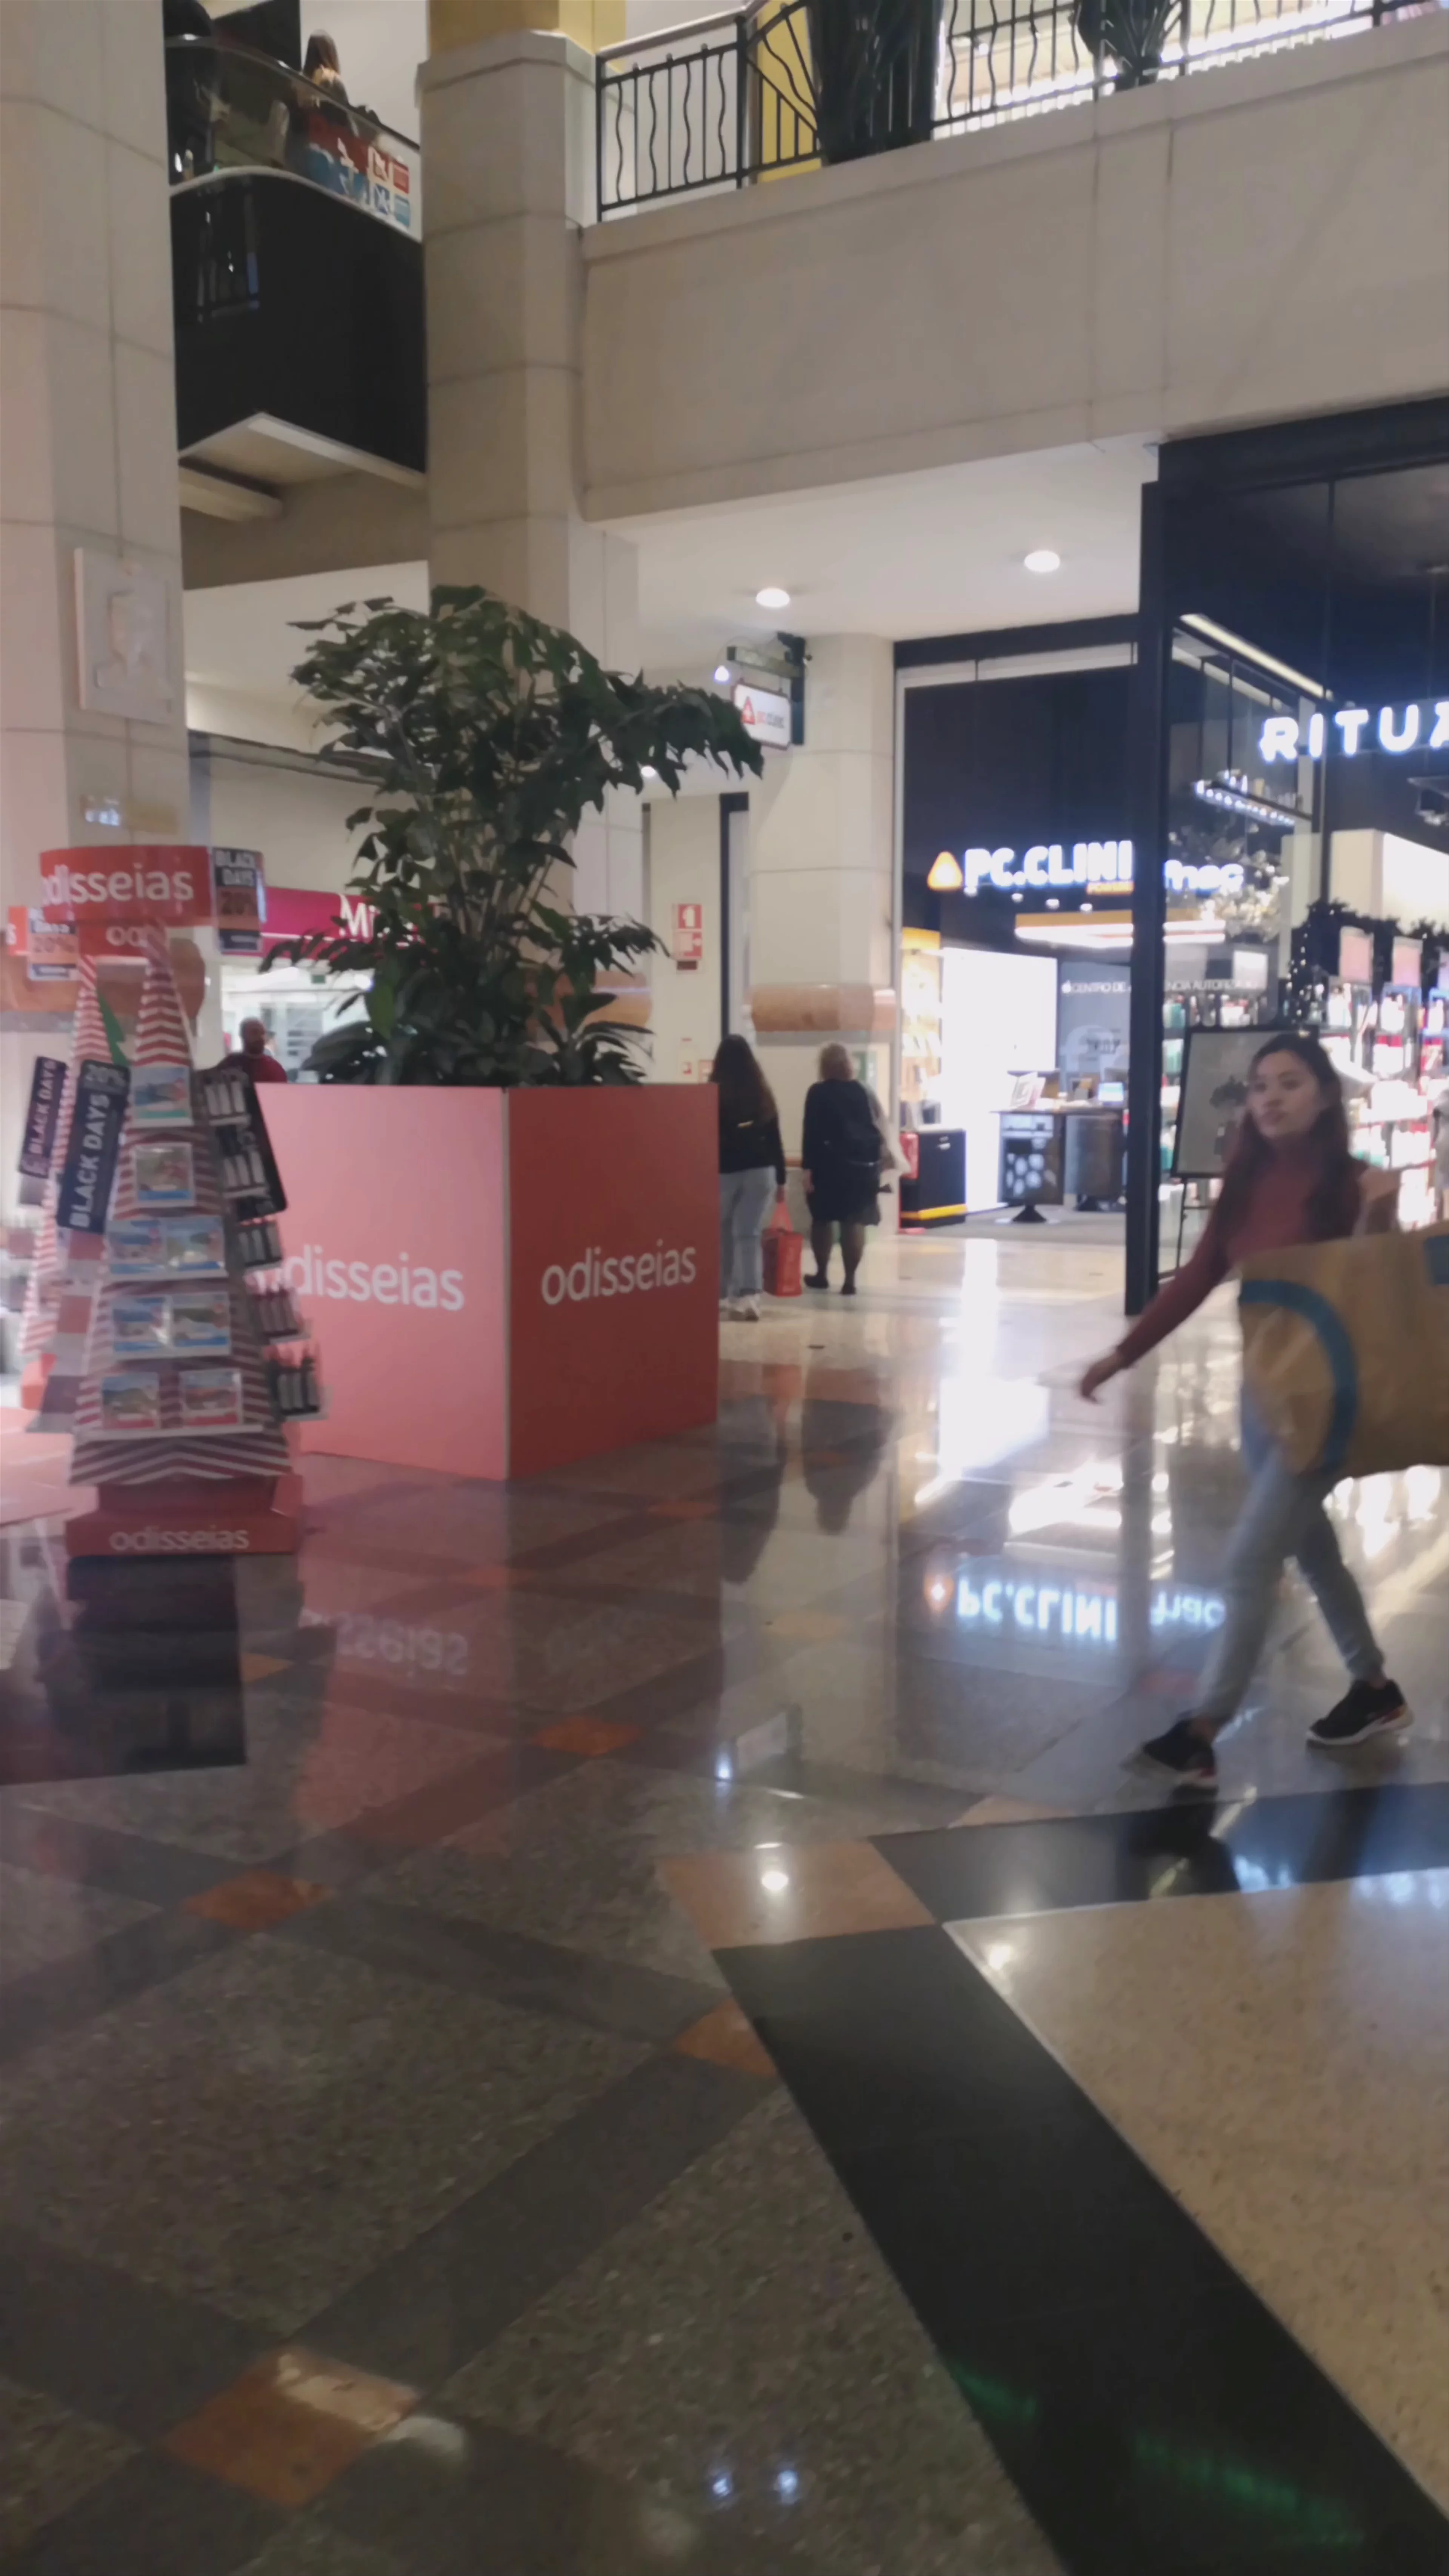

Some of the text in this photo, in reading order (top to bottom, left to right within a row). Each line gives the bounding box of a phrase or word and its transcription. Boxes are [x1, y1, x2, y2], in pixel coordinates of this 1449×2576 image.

[69, 1093, 110, 1228] BLACK DAYS
[541, 1238, 696, 1305] odisseias
[109, 1525, 249, 1551] odisseias
